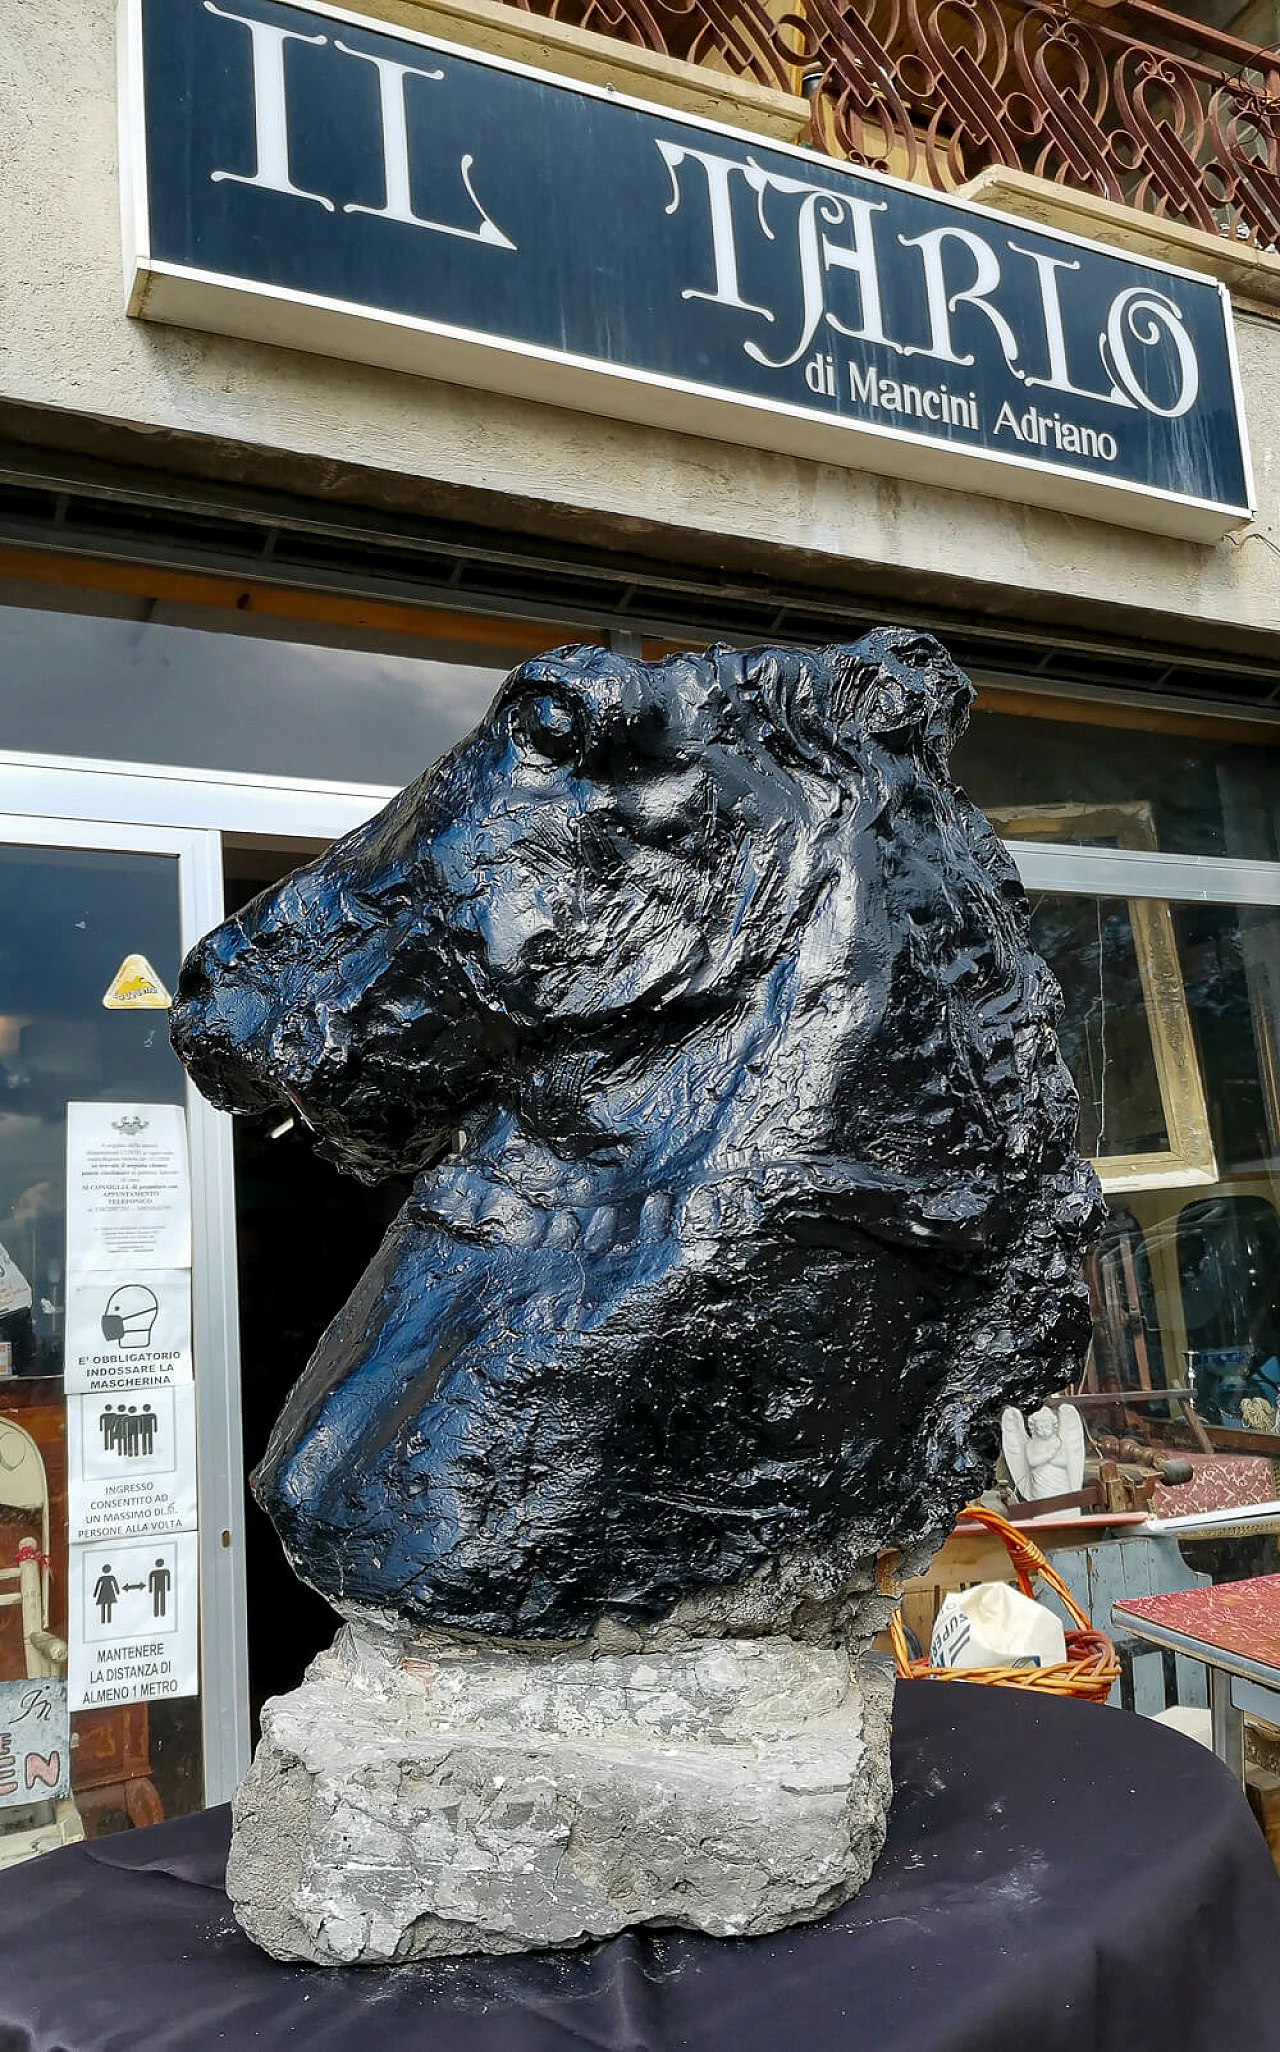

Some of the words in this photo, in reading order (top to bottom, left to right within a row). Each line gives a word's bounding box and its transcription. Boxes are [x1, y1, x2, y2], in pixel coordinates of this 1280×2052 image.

[203, 0, 518, 251] IL
[655, 139, 1199, 418] TARLO
[804, 353, 837, 397] di
[848, 361, 979, 431] Mancini
[993, 400, 1118, 461] Adriano
[78, 1356, 89, 1365] E'
[92, 1351, 181, 1365] OBBLIGATORIO
[86, 1364, 156, 1377] INDOSSARE
[159, 1363, 174, 1372] LA
[90, 1375, 171, 1389] MASCHERINA
[105, 1481, 154, 1495] INGRESSO
[90, 1495, 152, 1510] CONSENTITO
[154, 1493, 169, 1502] AD
[85, 1513, 100, 1524] UN
[103, 1508, 152, 1522] MASSIMO
[77, 1526, 124, 1538] PERSONE
[125, 1522, 148, 1533] ALLA
[151, 1518, 183, 1530] VOLTA
[97, 1643, 165, 1663] MANTENERE
[90, 1669, 103, 1684] LA
[105, 1662, 158, 1682] DISTANZA
[160, 1661, 171, 1674] DI
[82, 1686, 129, 1705] ALMENO
[131, 1685, 137, 1697] 1
[140, 1679, 179, 1696] METRO
